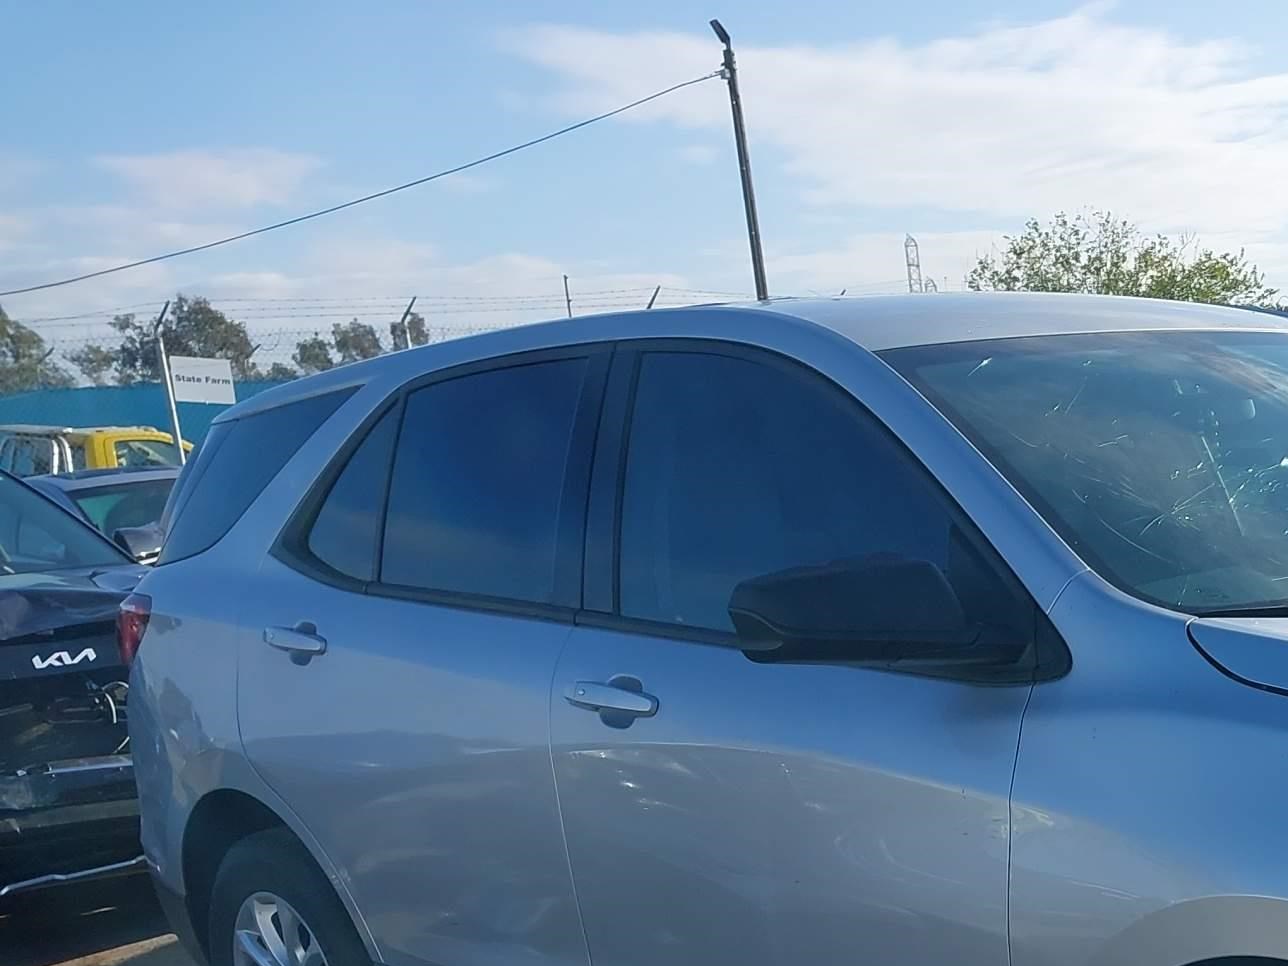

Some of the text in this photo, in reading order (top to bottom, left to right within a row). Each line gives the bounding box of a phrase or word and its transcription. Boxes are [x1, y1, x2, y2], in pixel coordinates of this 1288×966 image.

[174, 373, 231, 385] State Farm
[31, 647, 97, 669] KIA
